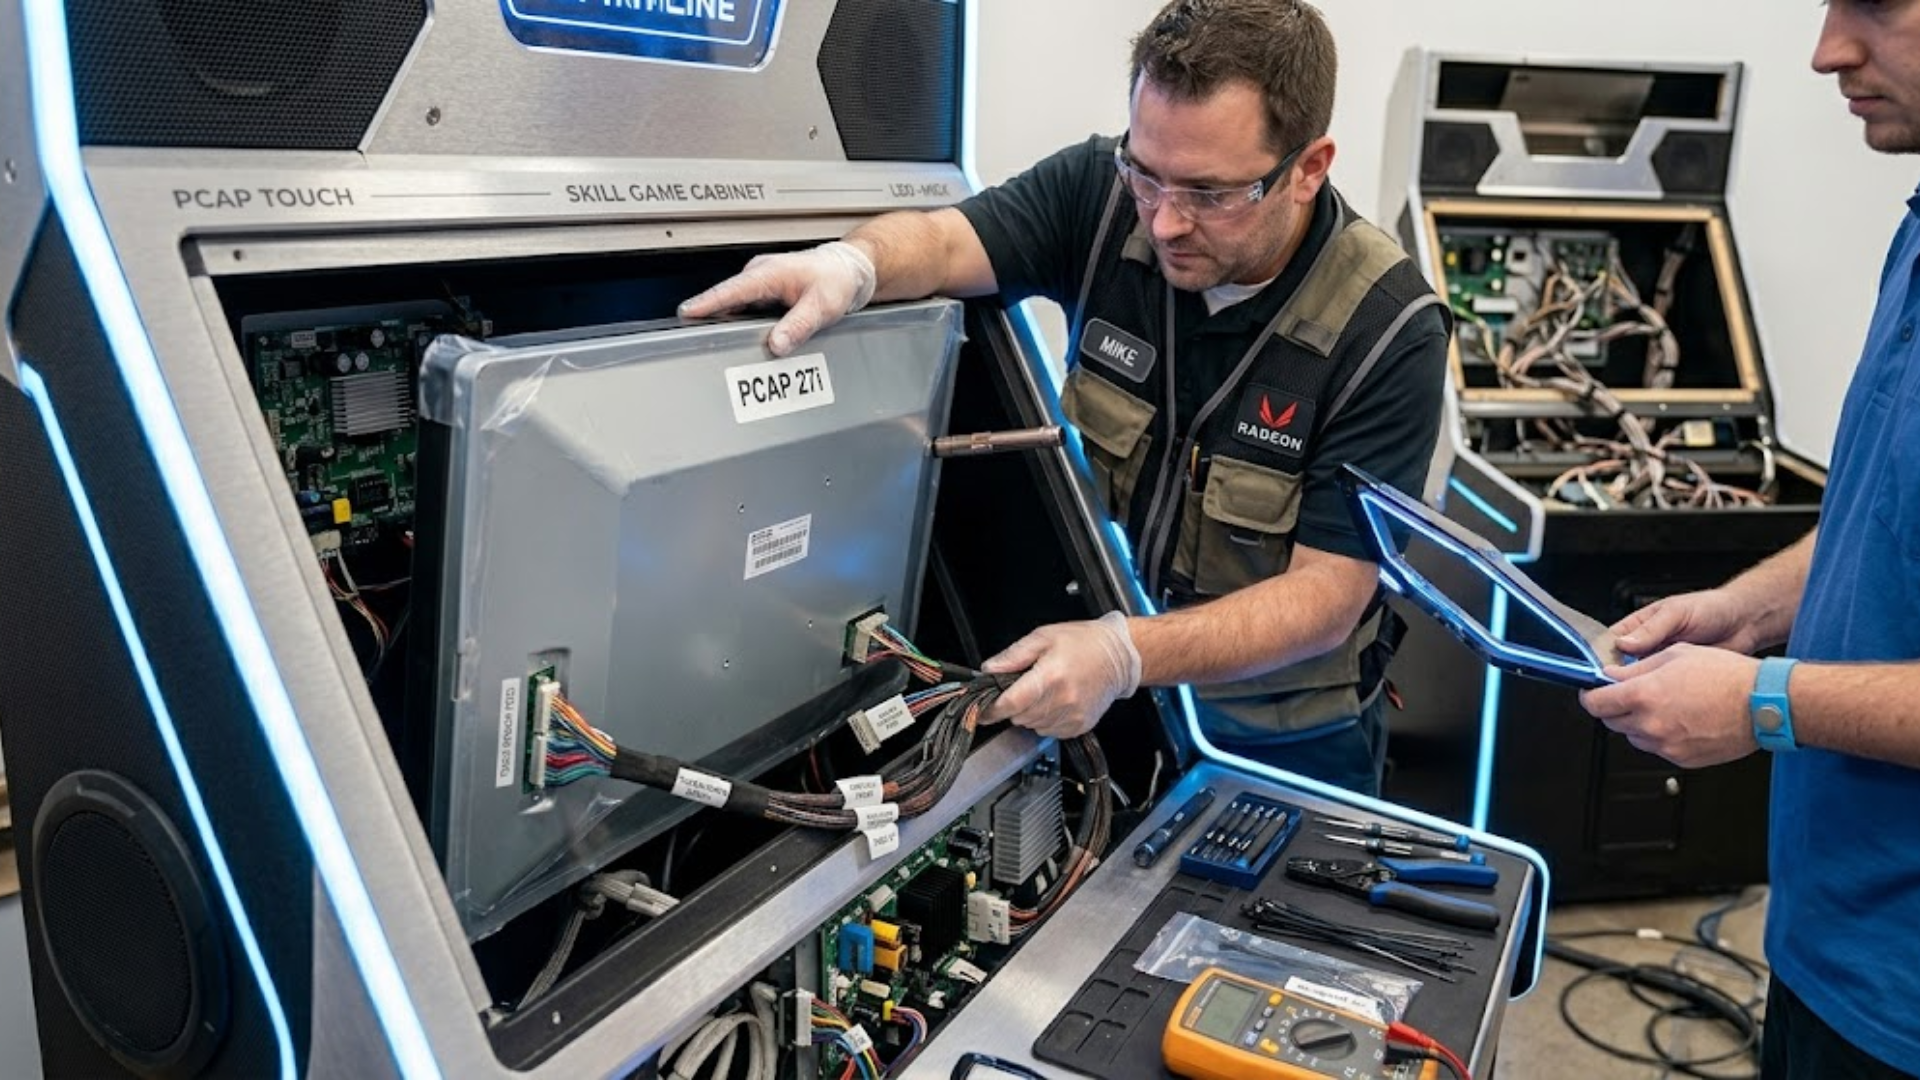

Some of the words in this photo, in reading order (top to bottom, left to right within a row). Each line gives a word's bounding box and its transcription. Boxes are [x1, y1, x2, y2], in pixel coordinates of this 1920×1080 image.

[172, 189, 252, 209] PCAP
[258, 187, 354, 207] TOUCH
[566, 184, 626, 202] SKILL
[629, 184, 688, 201] GAME
[690, 183, 765, 200] CABINET
[1099, 335, 1139, 367] MIKE
[738, 373, 791, 406] PCAP
[795, 366, 824, 395] 27i
[1237, 421, 1303, 451] RADEON
